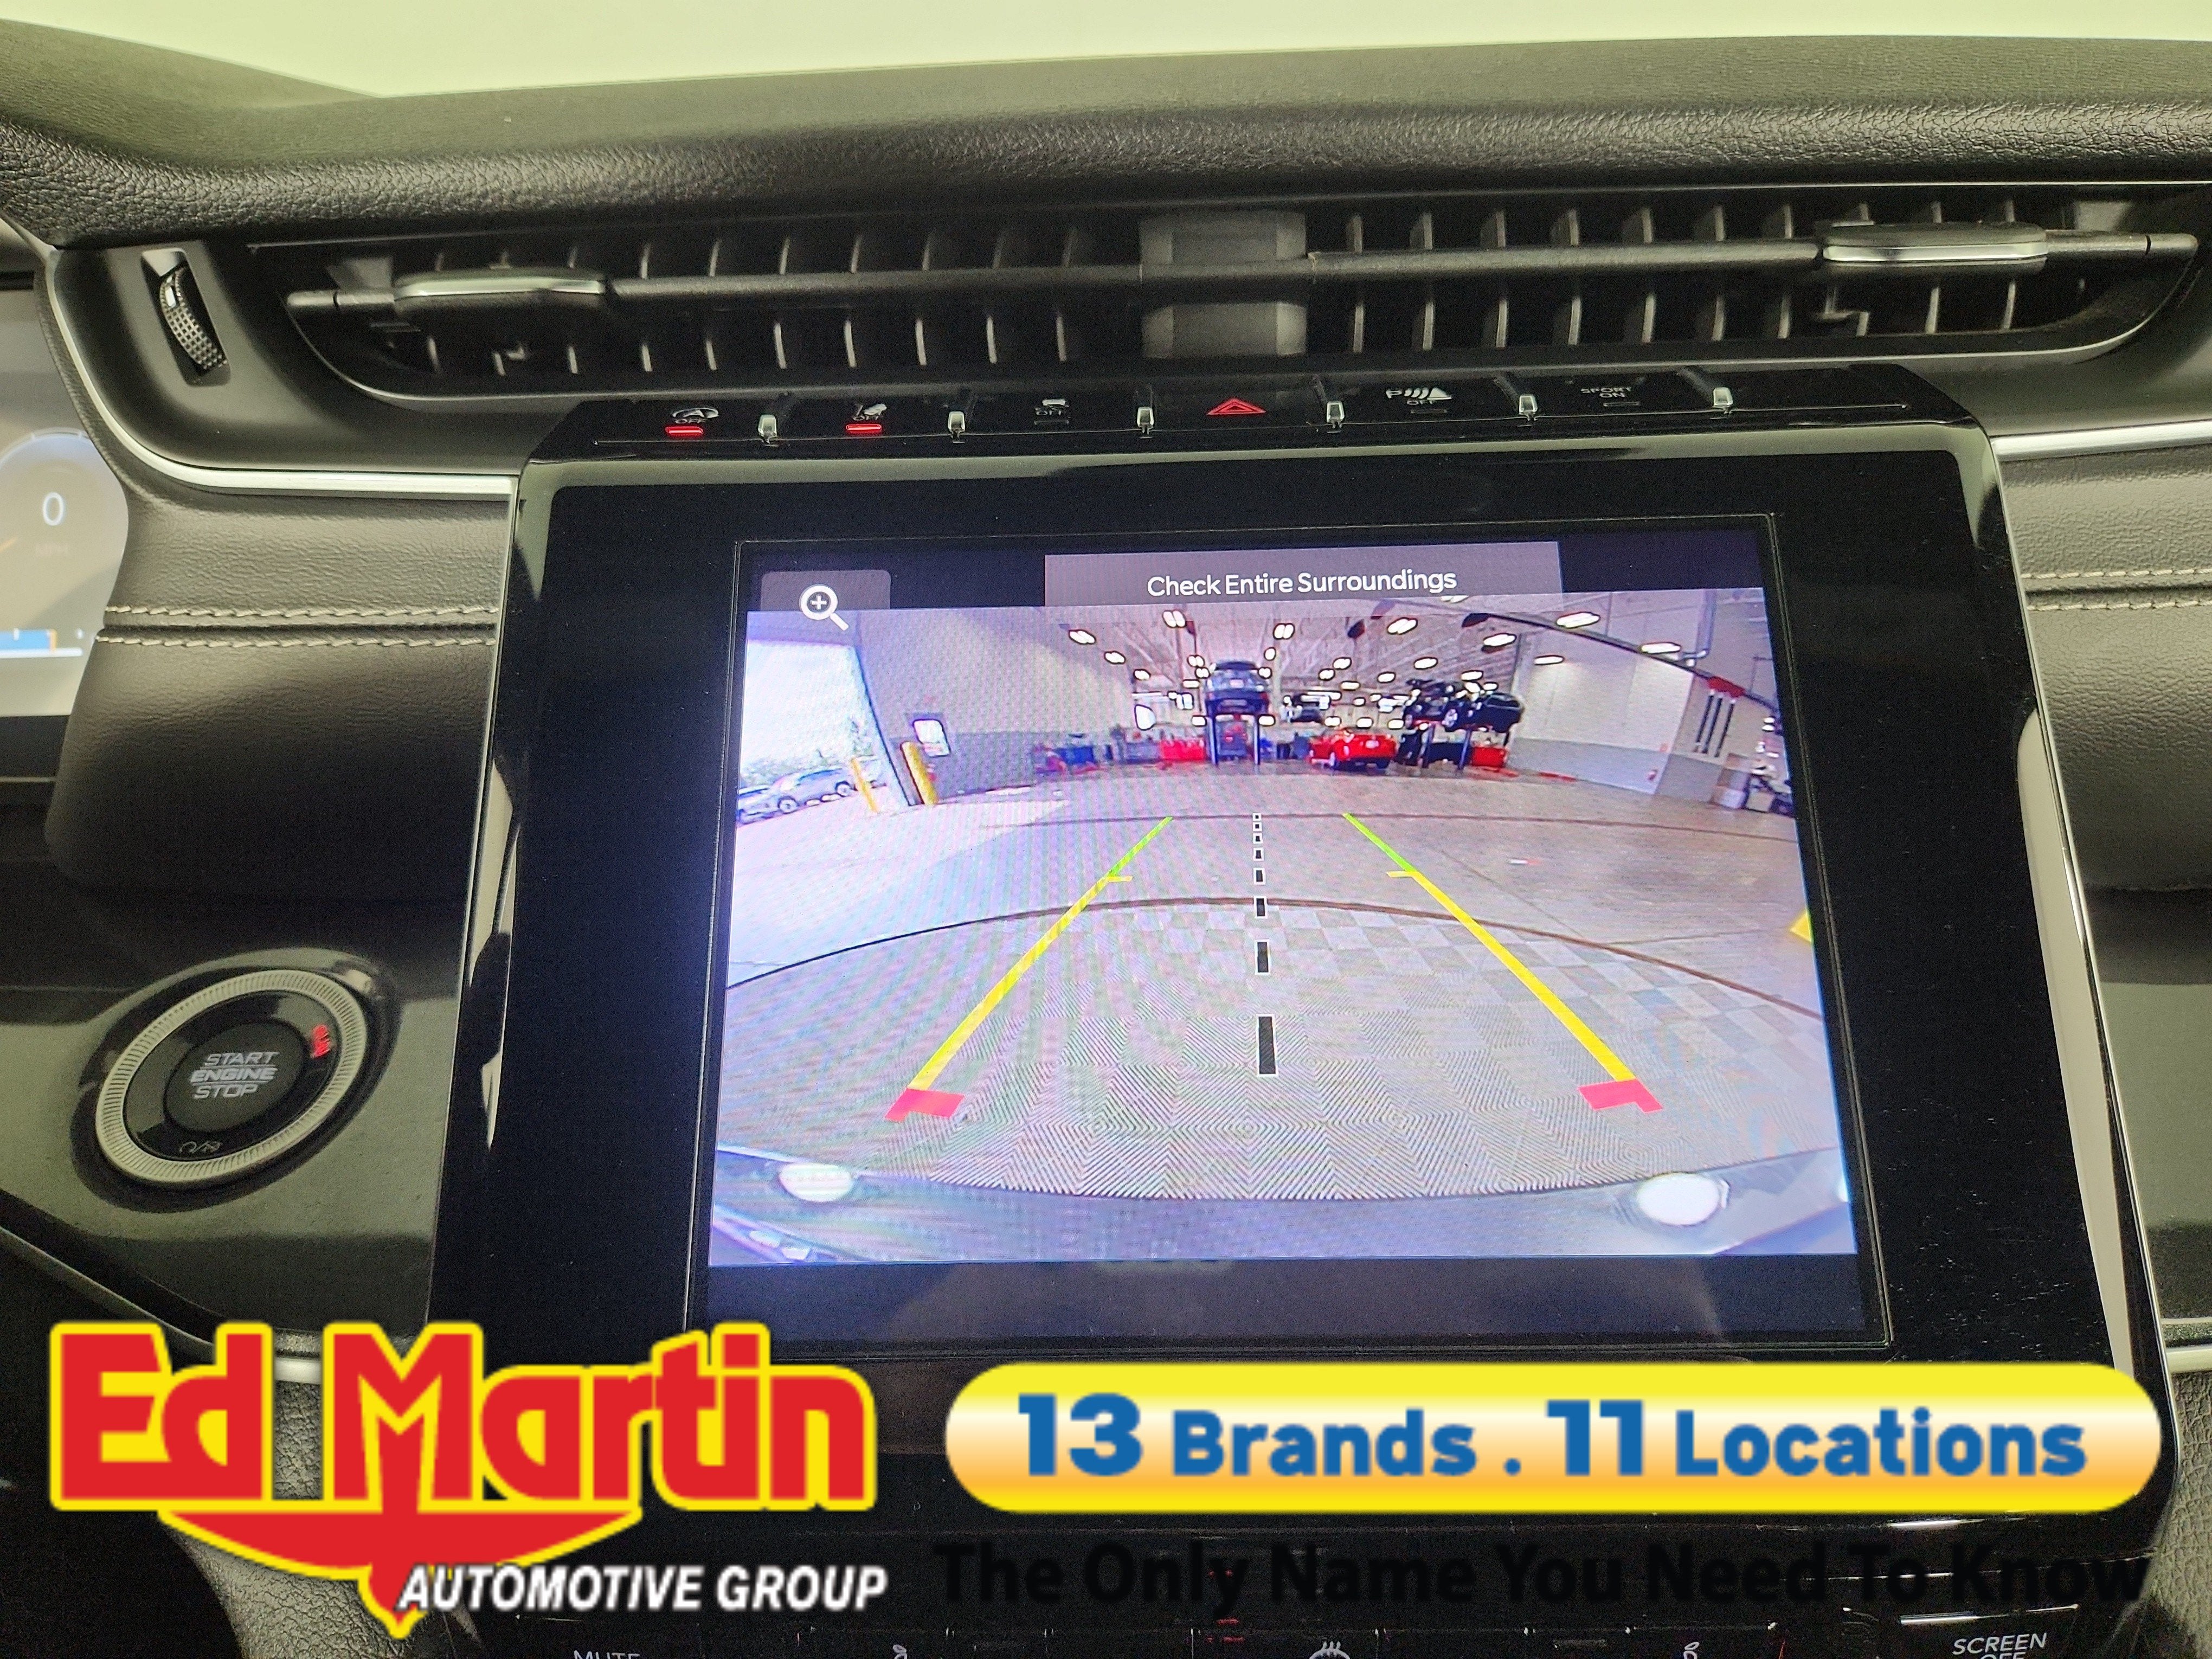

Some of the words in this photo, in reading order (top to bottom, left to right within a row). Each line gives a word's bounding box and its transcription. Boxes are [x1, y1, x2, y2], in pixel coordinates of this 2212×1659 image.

[42, 492, 64, 526] 0
[1147, 575, 1221, 597] Check
[1225, 573, 1293, 594] Entire
[1297, 569, 1457, 593] Surroundings
[204, 1052, 279, 1066] START
[190, 1068, 278, 1083] ENGINE
[193, 1084, 259, 1099] STOP
[1952, 1632, 2047, 1655] SCREEN
